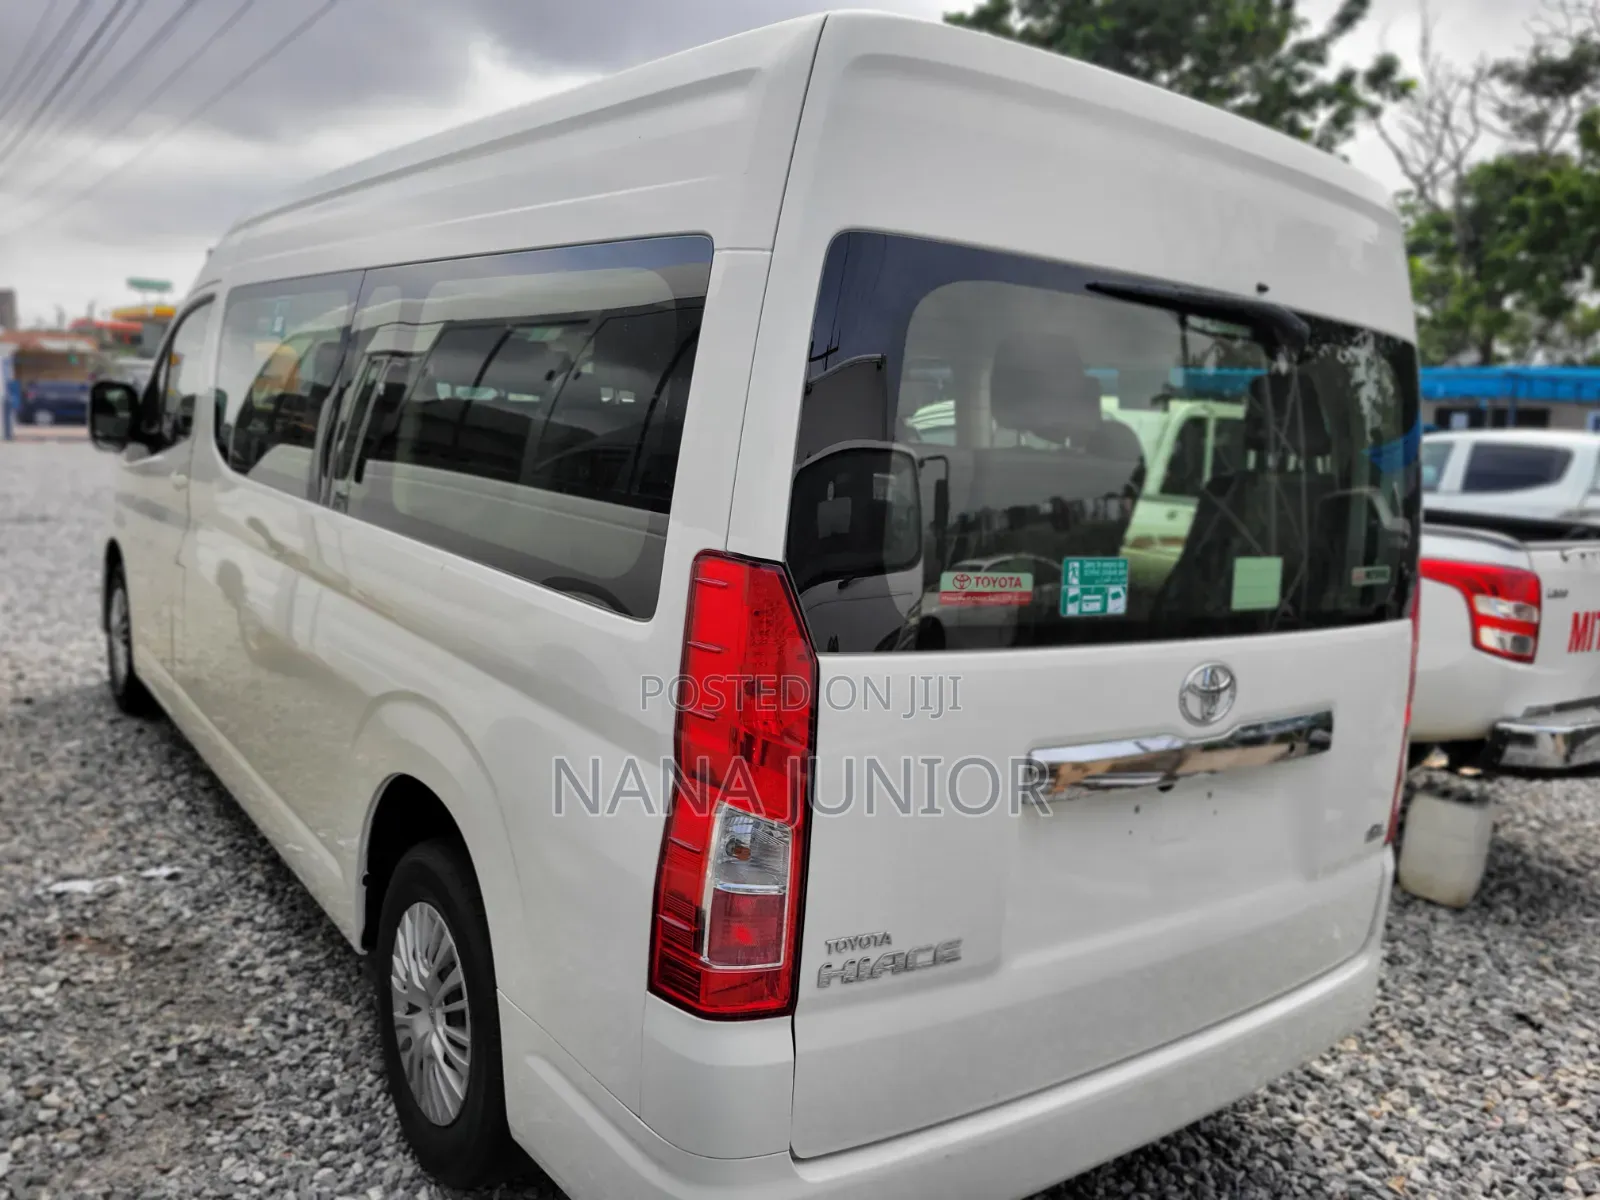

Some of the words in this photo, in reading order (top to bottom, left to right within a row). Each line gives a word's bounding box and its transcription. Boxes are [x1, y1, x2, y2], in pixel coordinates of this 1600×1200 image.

[974, 576, 1022, 588] TOYOTA
[1567, 611, 1600, 653] MI
[825, 932, 892, 955] TOYOTA
[816, 937, 963, 988] HIACE
